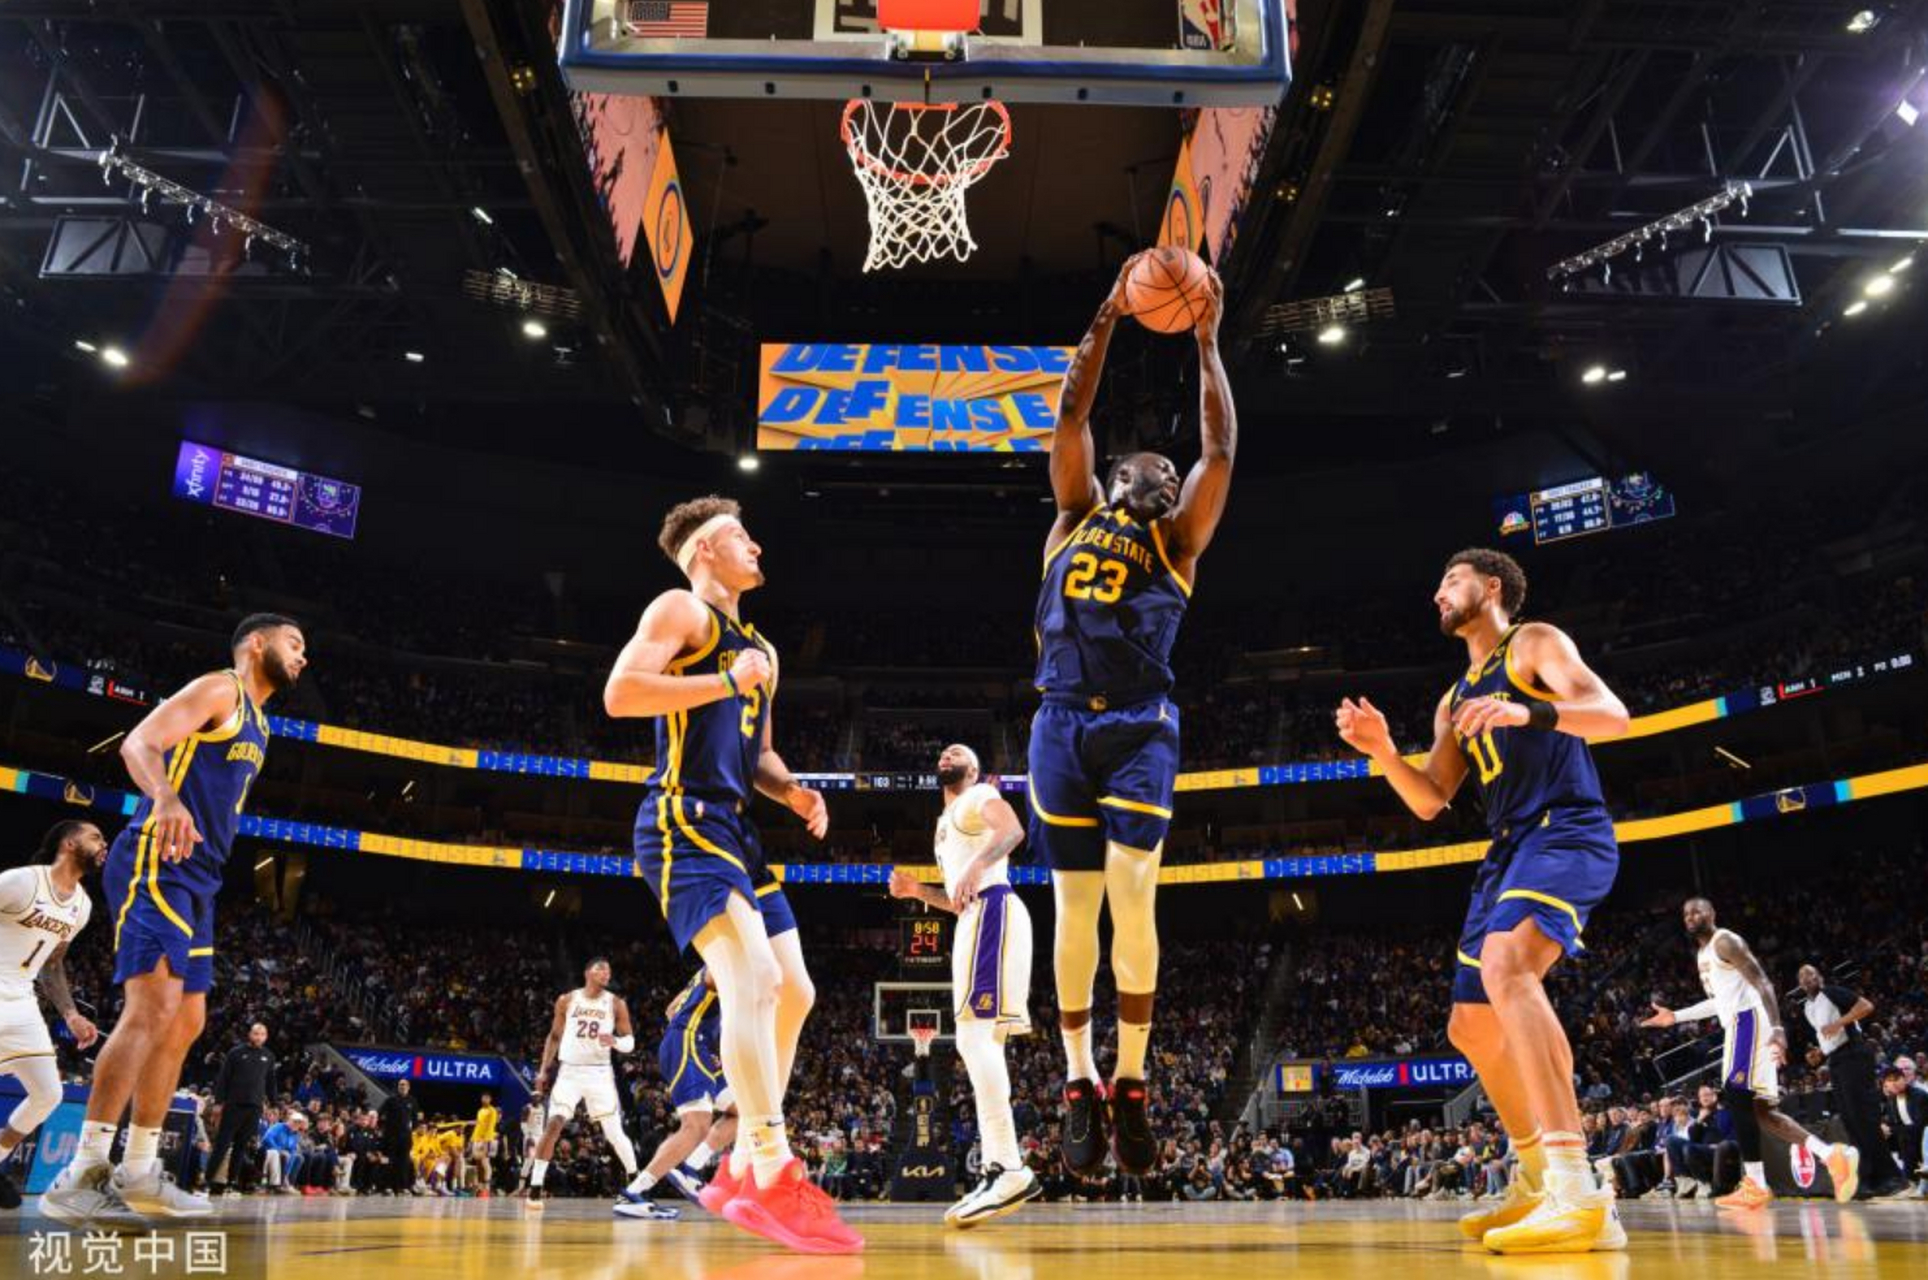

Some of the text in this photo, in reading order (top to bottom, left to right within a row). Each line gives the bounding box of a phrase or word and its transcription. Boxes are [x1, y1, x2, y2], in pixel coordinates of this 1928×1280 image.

[758, 380, 1056, 432] DEFENSE
[185, 449, 210, 498] xfinity
[1111, 535, 1153, 573] STATE
[1064, 552, 1128, 604] 23
[741, 687, 760, 738] 2
[478, 752, 590, 779] DEFENSE
[1259, 757, 1370, 785] DEFENSE
[239, 813, 360, 850] DEFENSE
[521, 849, 634, 876] DEFENSE
[1264, 852, 1377, 879] DEFENSE
[911, 934, 937, 955] 24
[576, 1020, 599, 1039] 28
[428, 1059, 493, 1079] ULTRA
